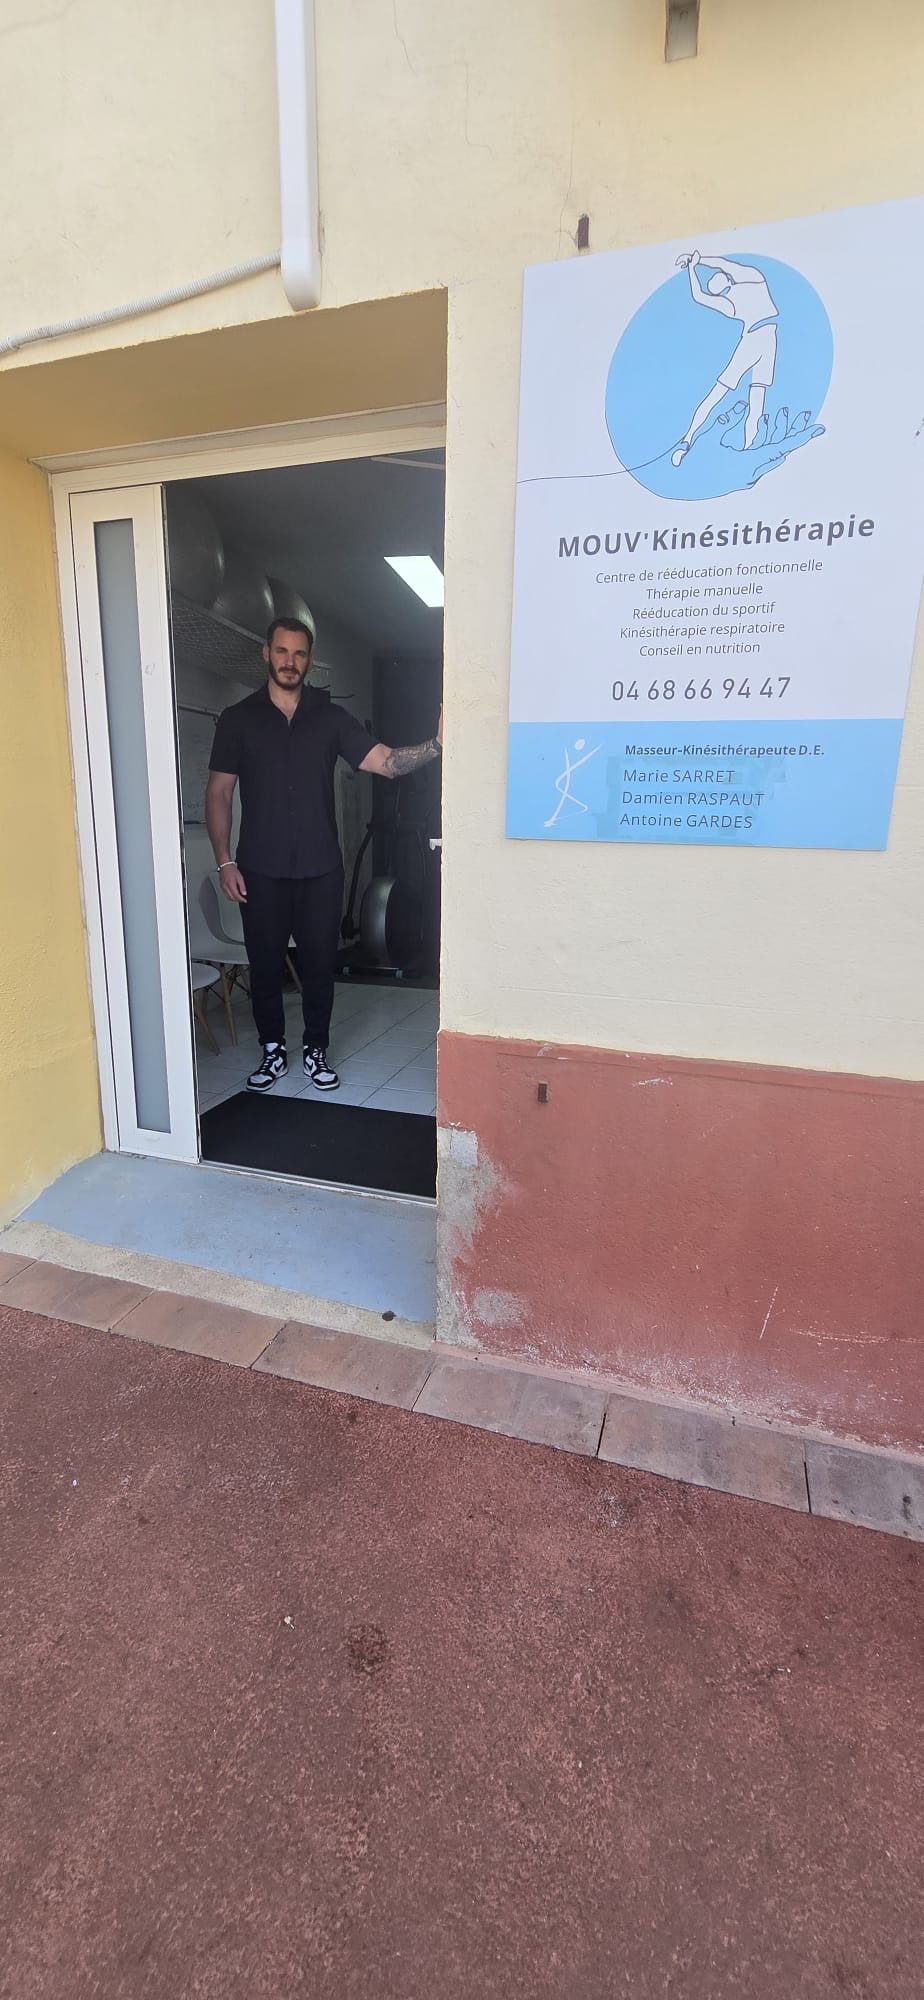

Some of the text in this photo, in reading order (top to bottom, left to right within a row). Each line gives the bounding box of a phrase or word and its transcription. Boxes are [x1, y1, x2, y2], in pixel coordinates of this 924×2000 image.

[558, 513, 875, 557] MOUV'Kinésithérapie
[595, 559, 823, 584] Centre de rééducation fonctionnelle
[646, 583, 763, 602] Thérapie manuelle
[632, 601, 776, 620] Rééducation du sportif
[620, 621, 785, 639] Kinésithérapie respiratoire
[639, 642, 761, 656] Conseil en nutrition
[612, 676, 791, 701] 04 68 66 94 47
[625, 744, 825, 758] Masseur-Kinésithérapeute D.E.
[623, 769, 736, 784] Marie SARRET
[622, 791, 765, 807] Damien RASPAUT
[620, 813, 753, 829] Antoine GARDES
